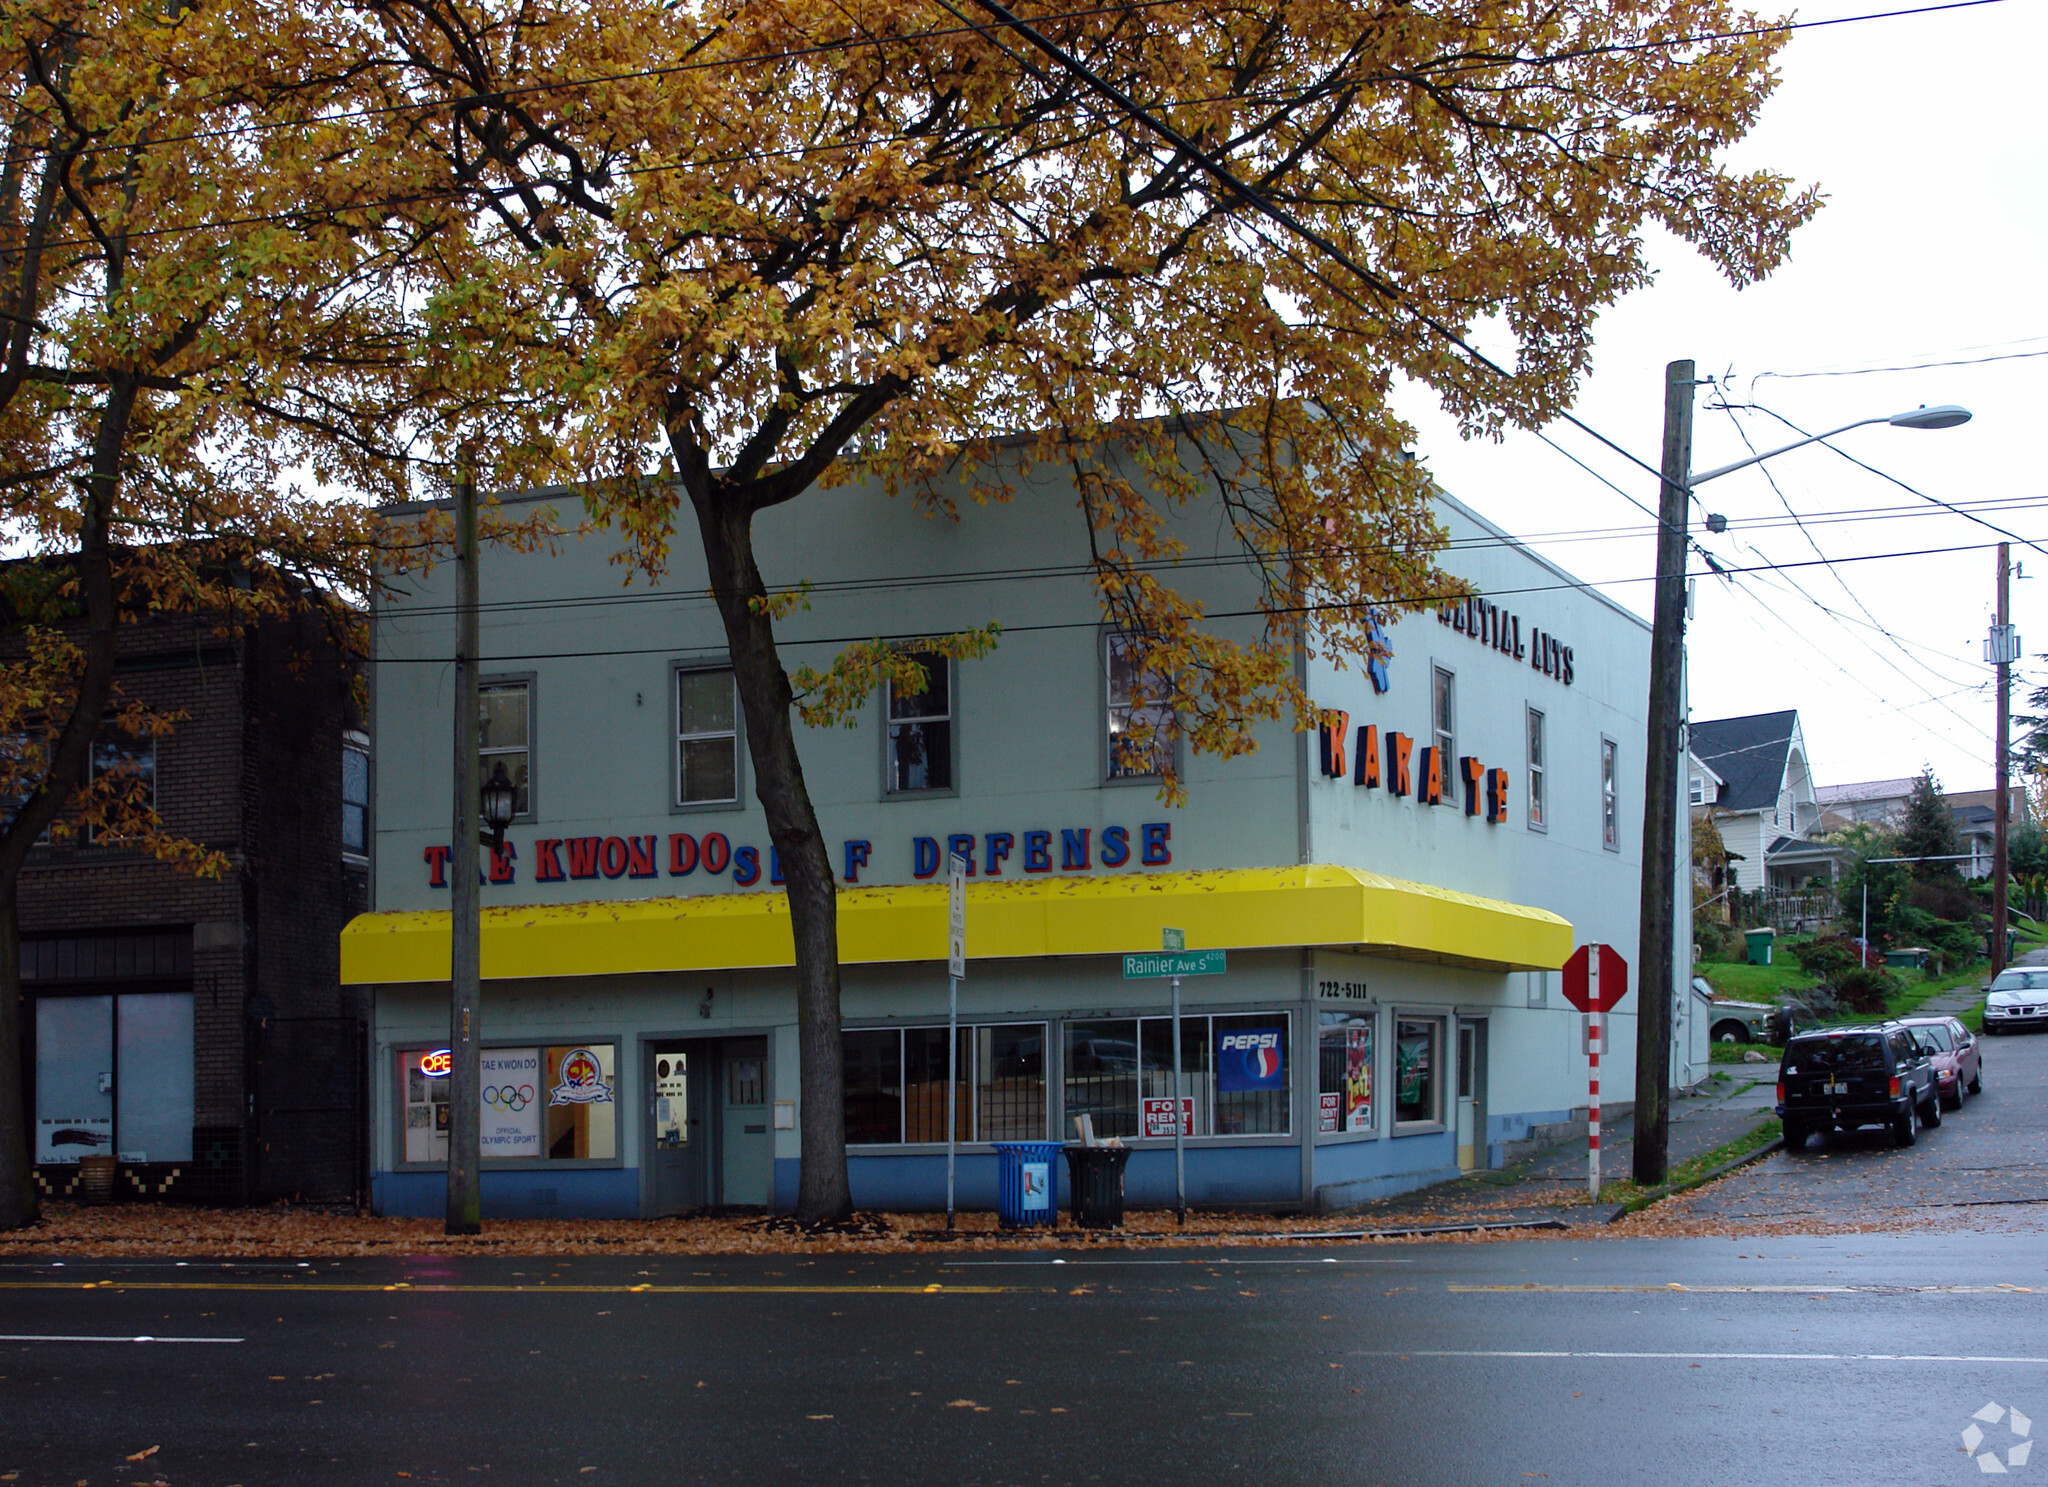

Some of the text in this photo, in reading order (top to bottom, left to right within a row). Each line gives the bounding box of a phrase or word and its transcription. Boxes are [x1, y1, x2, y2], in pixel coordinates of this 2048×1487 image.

[1531, 627, 1575, 686] ARTS
[1319, 708, 1509, 823] KARATE
[913, 822, 1171, 879] DEFENSE
[424, 832, 731, 888] TE KWON DO
[1126, 952, 1225, 974] Rainier Ave S 4200
[1319, 981, 1367, 999] 722-5111
[1221, 1033, 1278, 1051] PEPSI
[421, 1054, 452, 1071] OPE
[481, 1058, 537, 1071] TAE KWON DO
[1322, 1097, 1336, 1108] FOR
[1320, 1108, 1338, 1119] RENT
[481, 1135, 537, 1144] OLYMPIC SPORT
